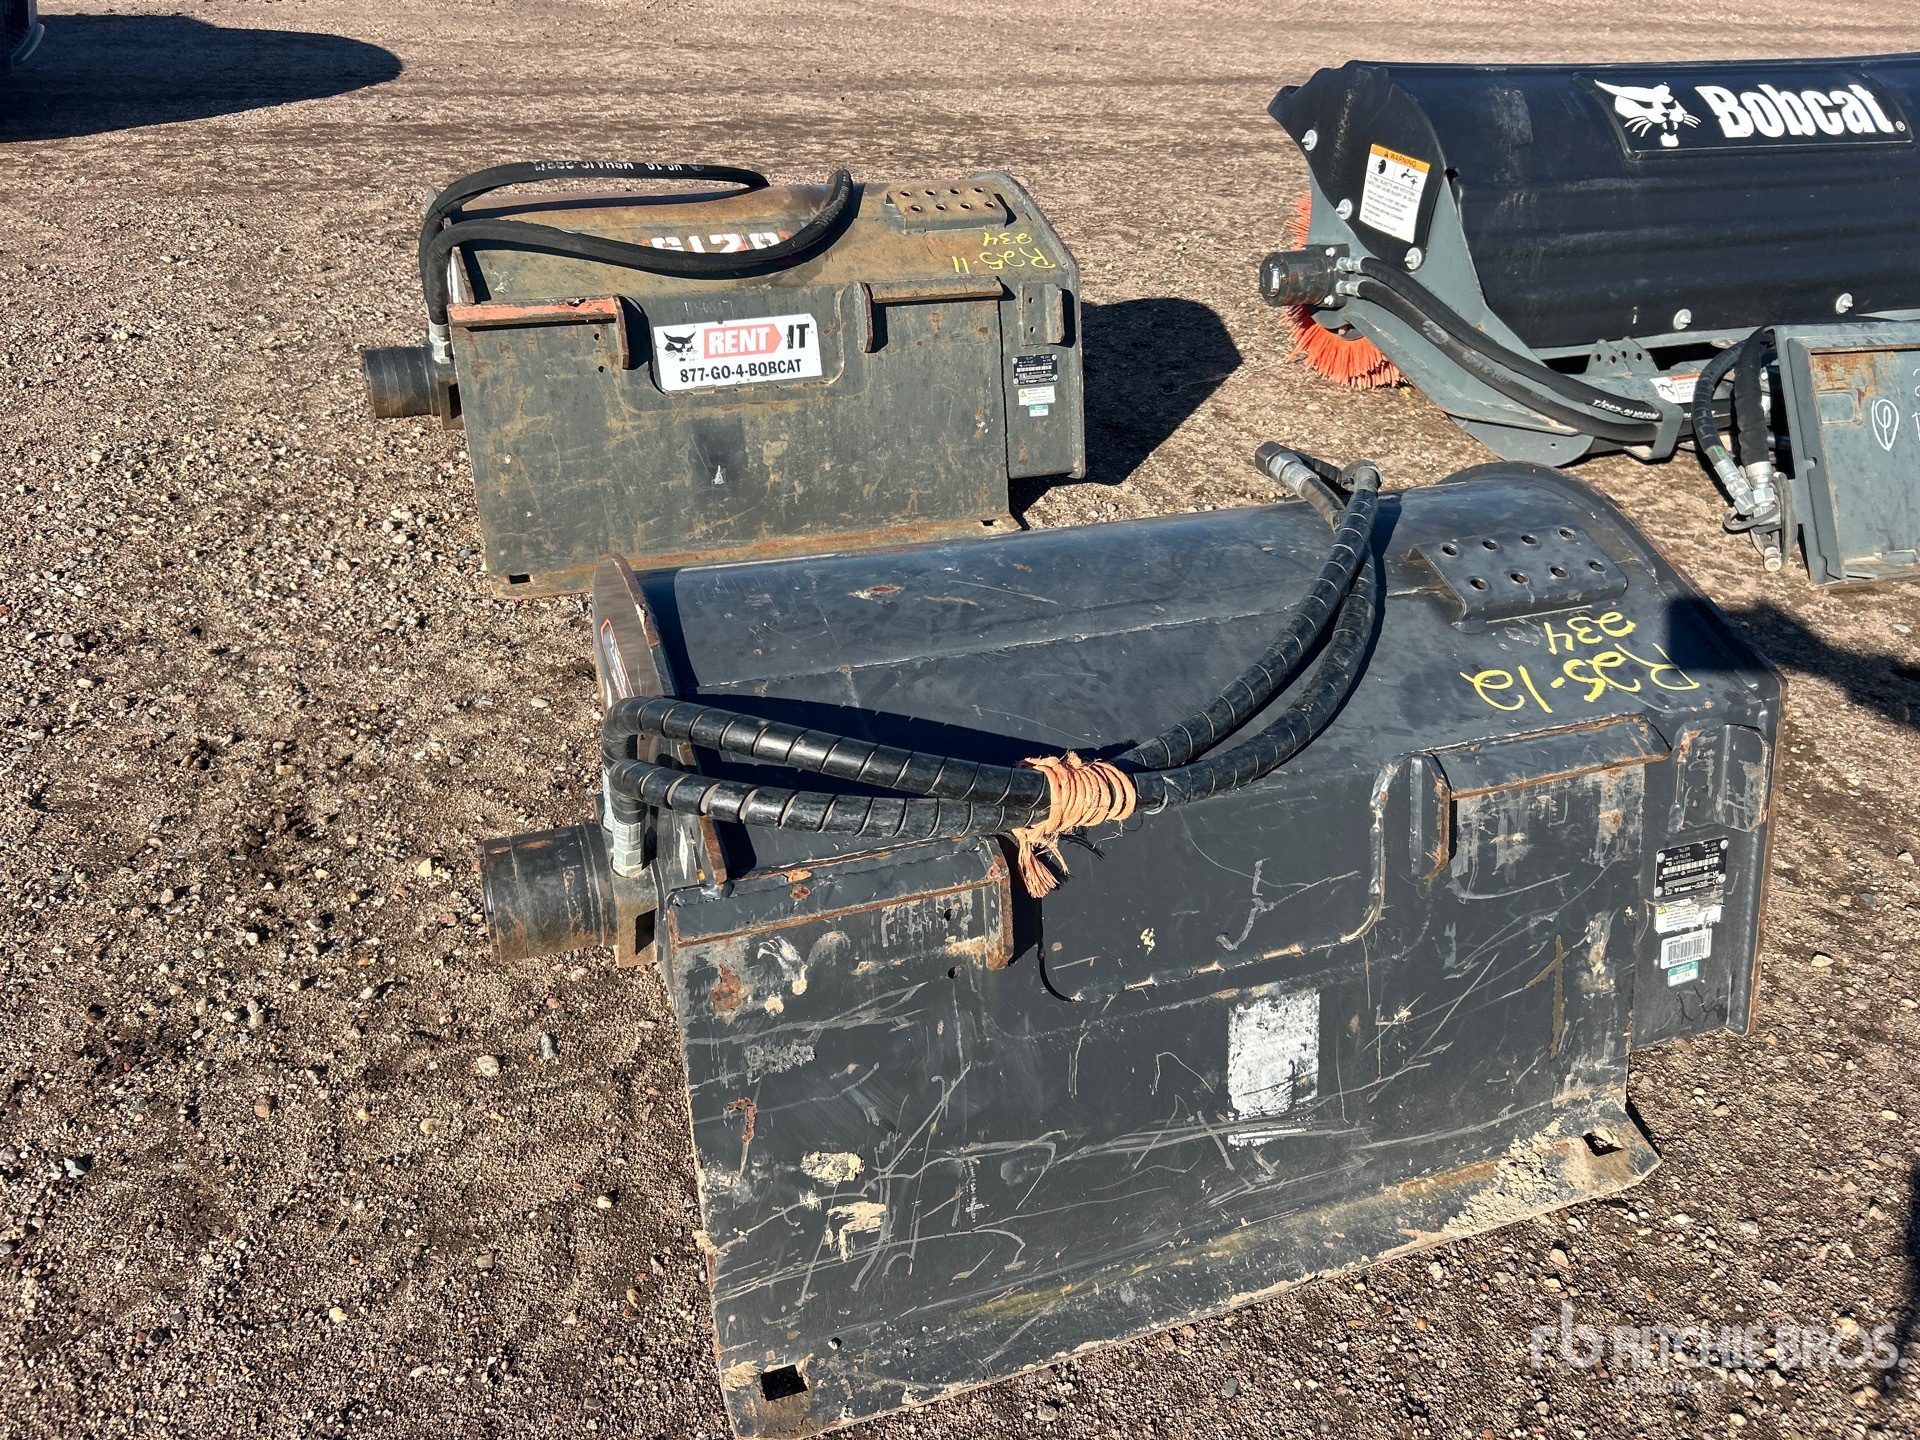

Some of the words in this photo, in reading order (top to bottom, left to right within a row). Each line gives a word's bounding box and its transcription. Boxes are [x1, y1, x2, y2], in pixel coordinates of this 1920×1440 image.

[1694, 84, 1895, 138] Bobcat
[1390, 154, 1417, 168] WARNING
[983, 232, 1032, 246] 234
[708, 327, 770, 355] RENT
[787, 323, 810, 349] IT
[680, 359, 802, 383] 877-GO-4-BOBCAT
[1543, 611, 1636, 655] 234
